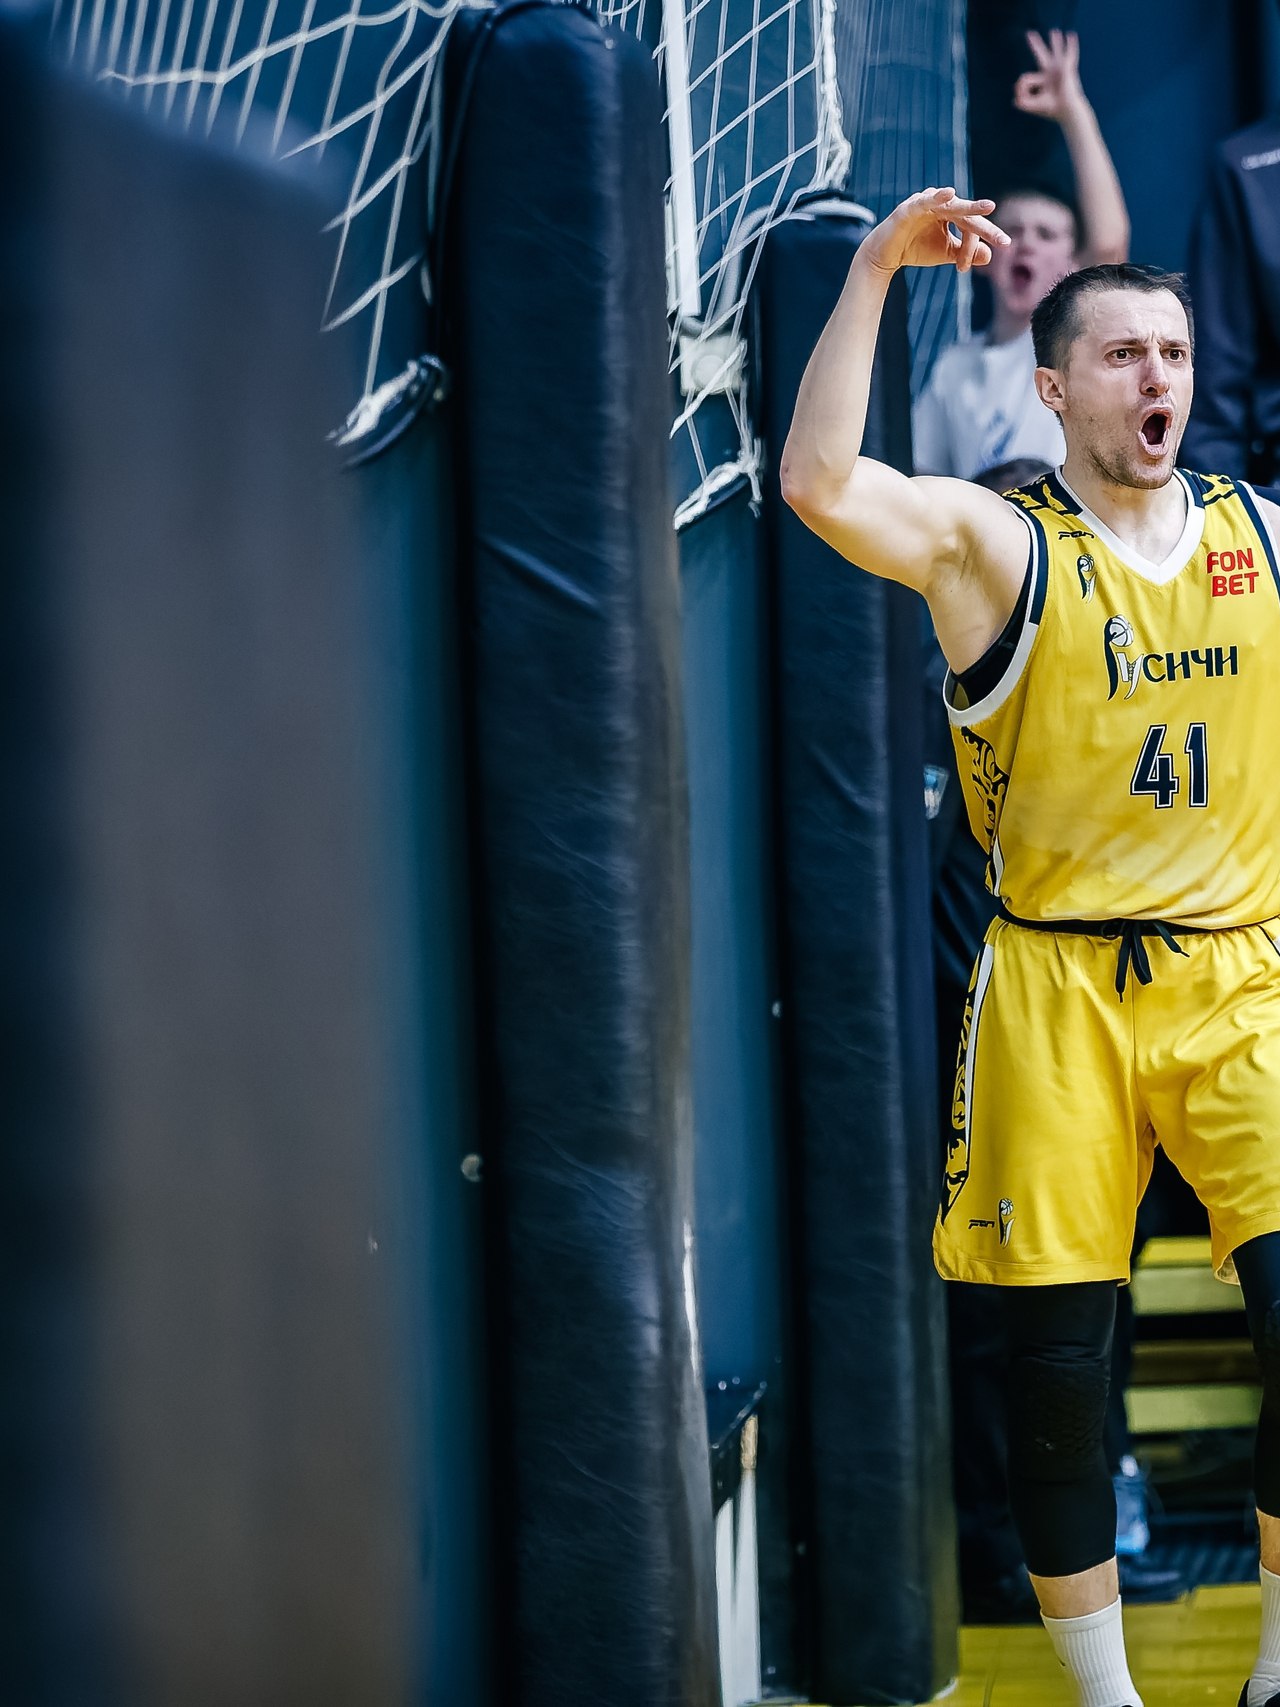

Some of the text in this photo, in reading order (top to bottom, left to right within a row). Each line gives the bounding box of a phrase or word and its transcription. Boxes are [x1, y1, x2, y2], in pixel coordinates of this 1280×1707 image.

[1207, 548, 1254, 573] FON
[1212, 572, 1259, 597] BET
[1130, 722, 1208, 809] 41
